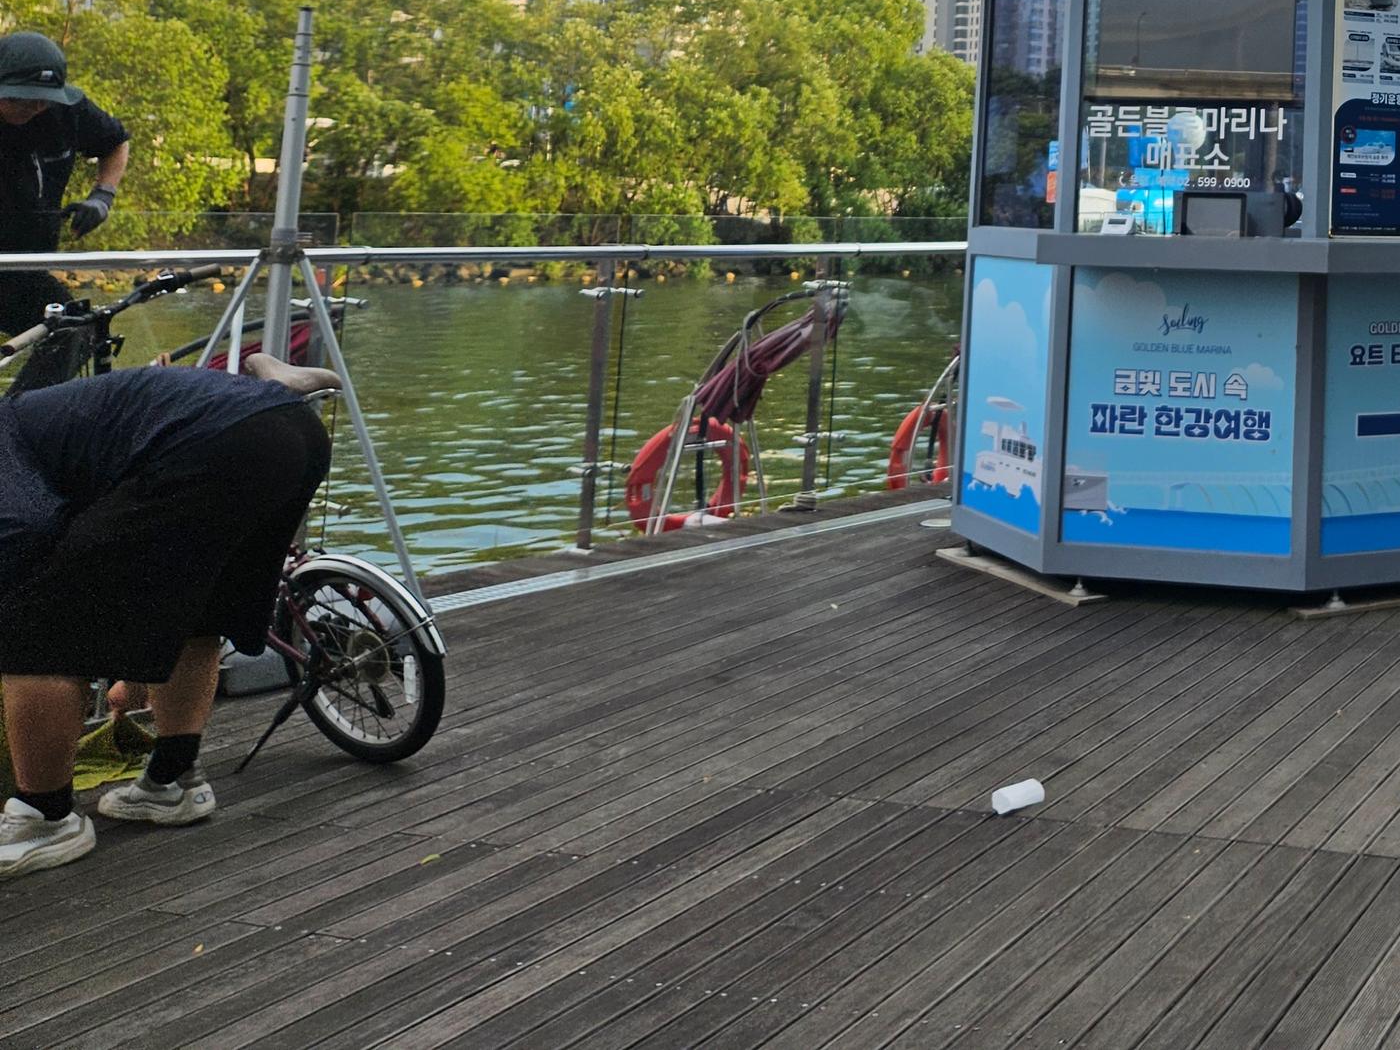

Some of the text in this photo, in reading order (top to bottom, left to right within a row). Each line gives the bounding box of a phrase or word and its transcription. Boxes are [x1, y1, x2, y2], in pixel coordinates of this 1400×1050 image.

[1146, 143, 1230, 170] 매표소
[1133, 342, 1232, 355] GOLDEN BLUE MARINA
[1350, 344, 1384, 366] 요트
[1114, 368, 1249, 401] 금빛 도시 속
[1089, 402, 1273, 443] 파란 한강여행
